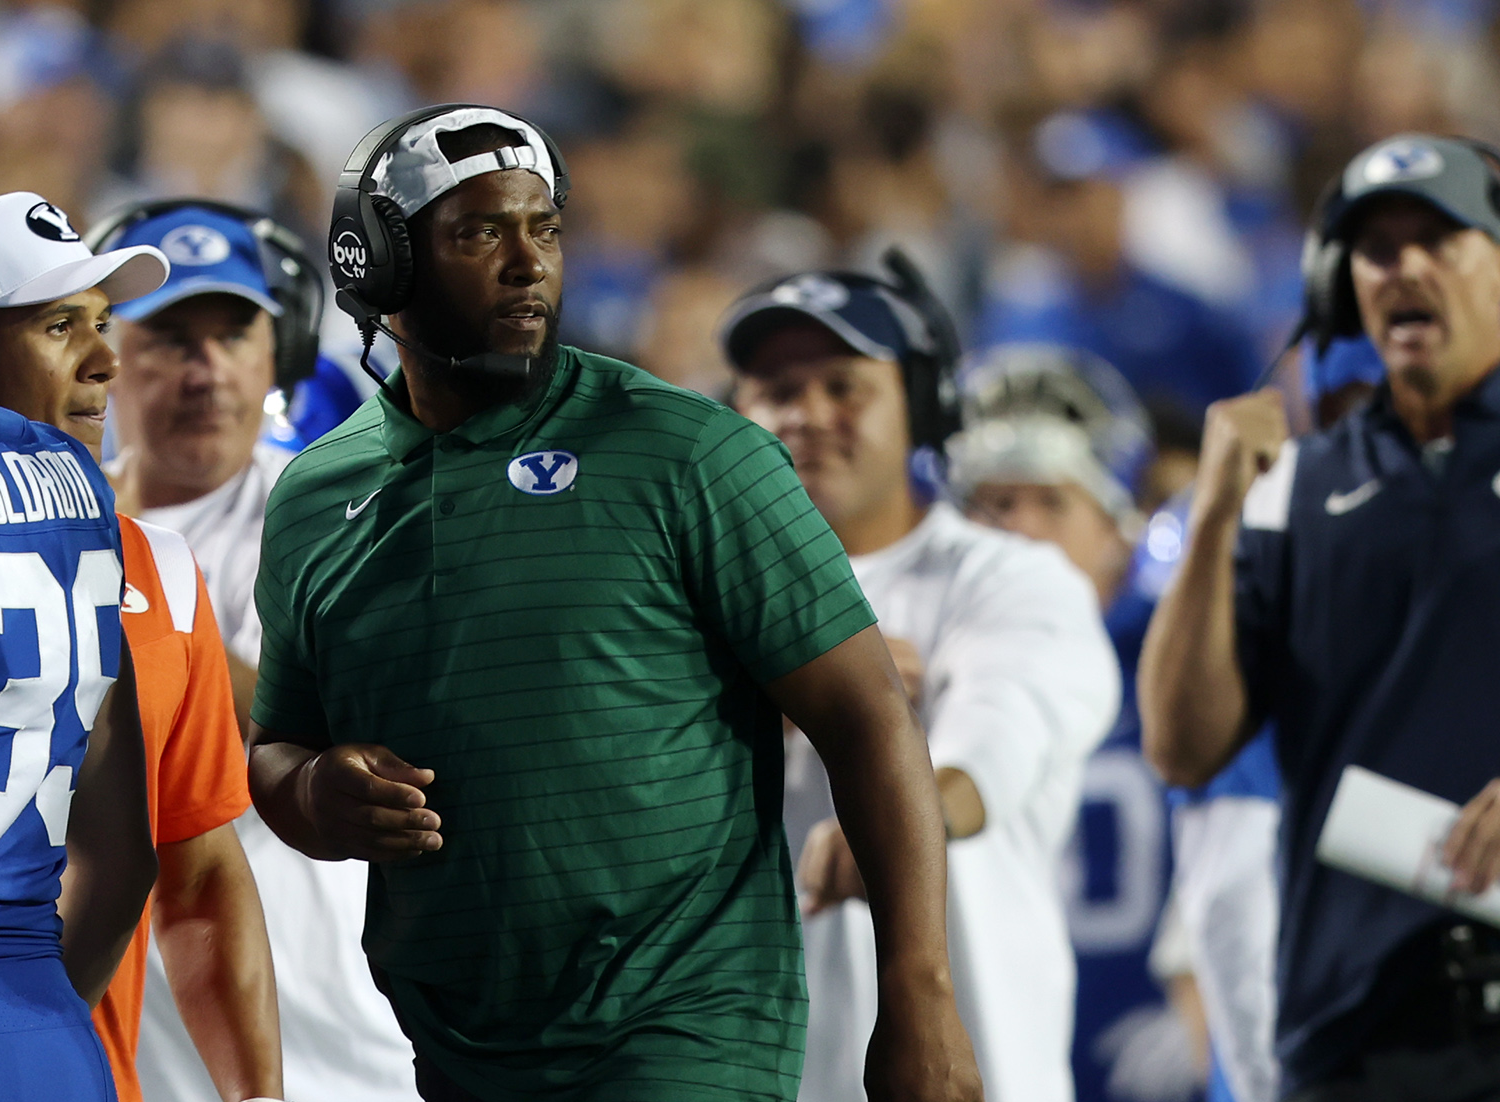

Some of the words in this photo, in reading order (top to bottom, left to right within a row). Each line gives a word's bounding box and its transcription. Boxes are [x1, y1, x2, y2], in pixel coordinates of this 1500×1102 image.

[29, 203, 80, 240] Y
[333, 242, 366, 265] byu
[352, 264, 366, 279] tv
[518, 453, 571, 490] Y
